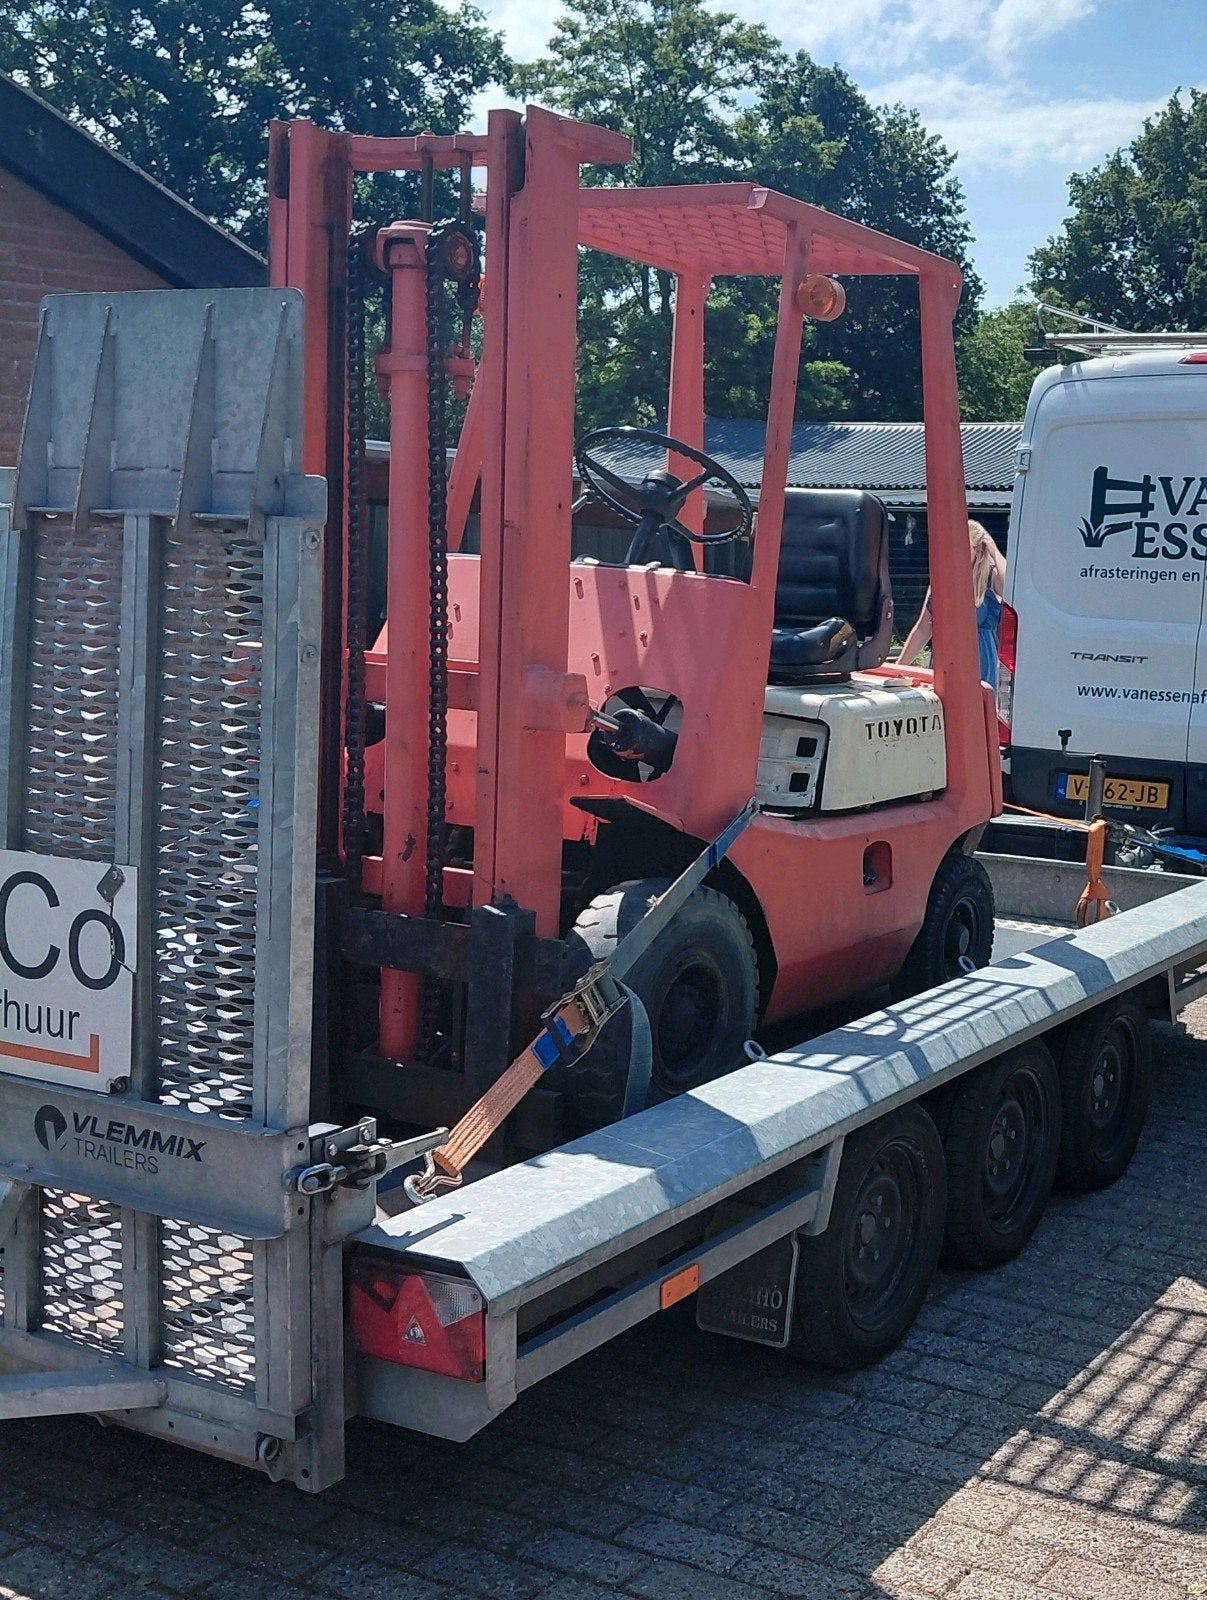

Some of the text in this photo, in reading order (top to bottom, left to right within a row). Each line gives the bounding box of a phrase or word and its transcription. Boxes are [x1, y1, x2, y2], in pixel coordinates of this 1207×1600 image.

[1131, 521, 1207, 560] ESS
[1079, 564, 1200, 583] afrasteringen en
[1070, 651, 1149, 664] TRANSIT
[865, 714, 942, 740] TOYOTA
[0, 988, 81, 1041] huur
[72, 1111, 207, 1162] VLEMMIX
[73, 1137, 159, 1174] TRAILERS
